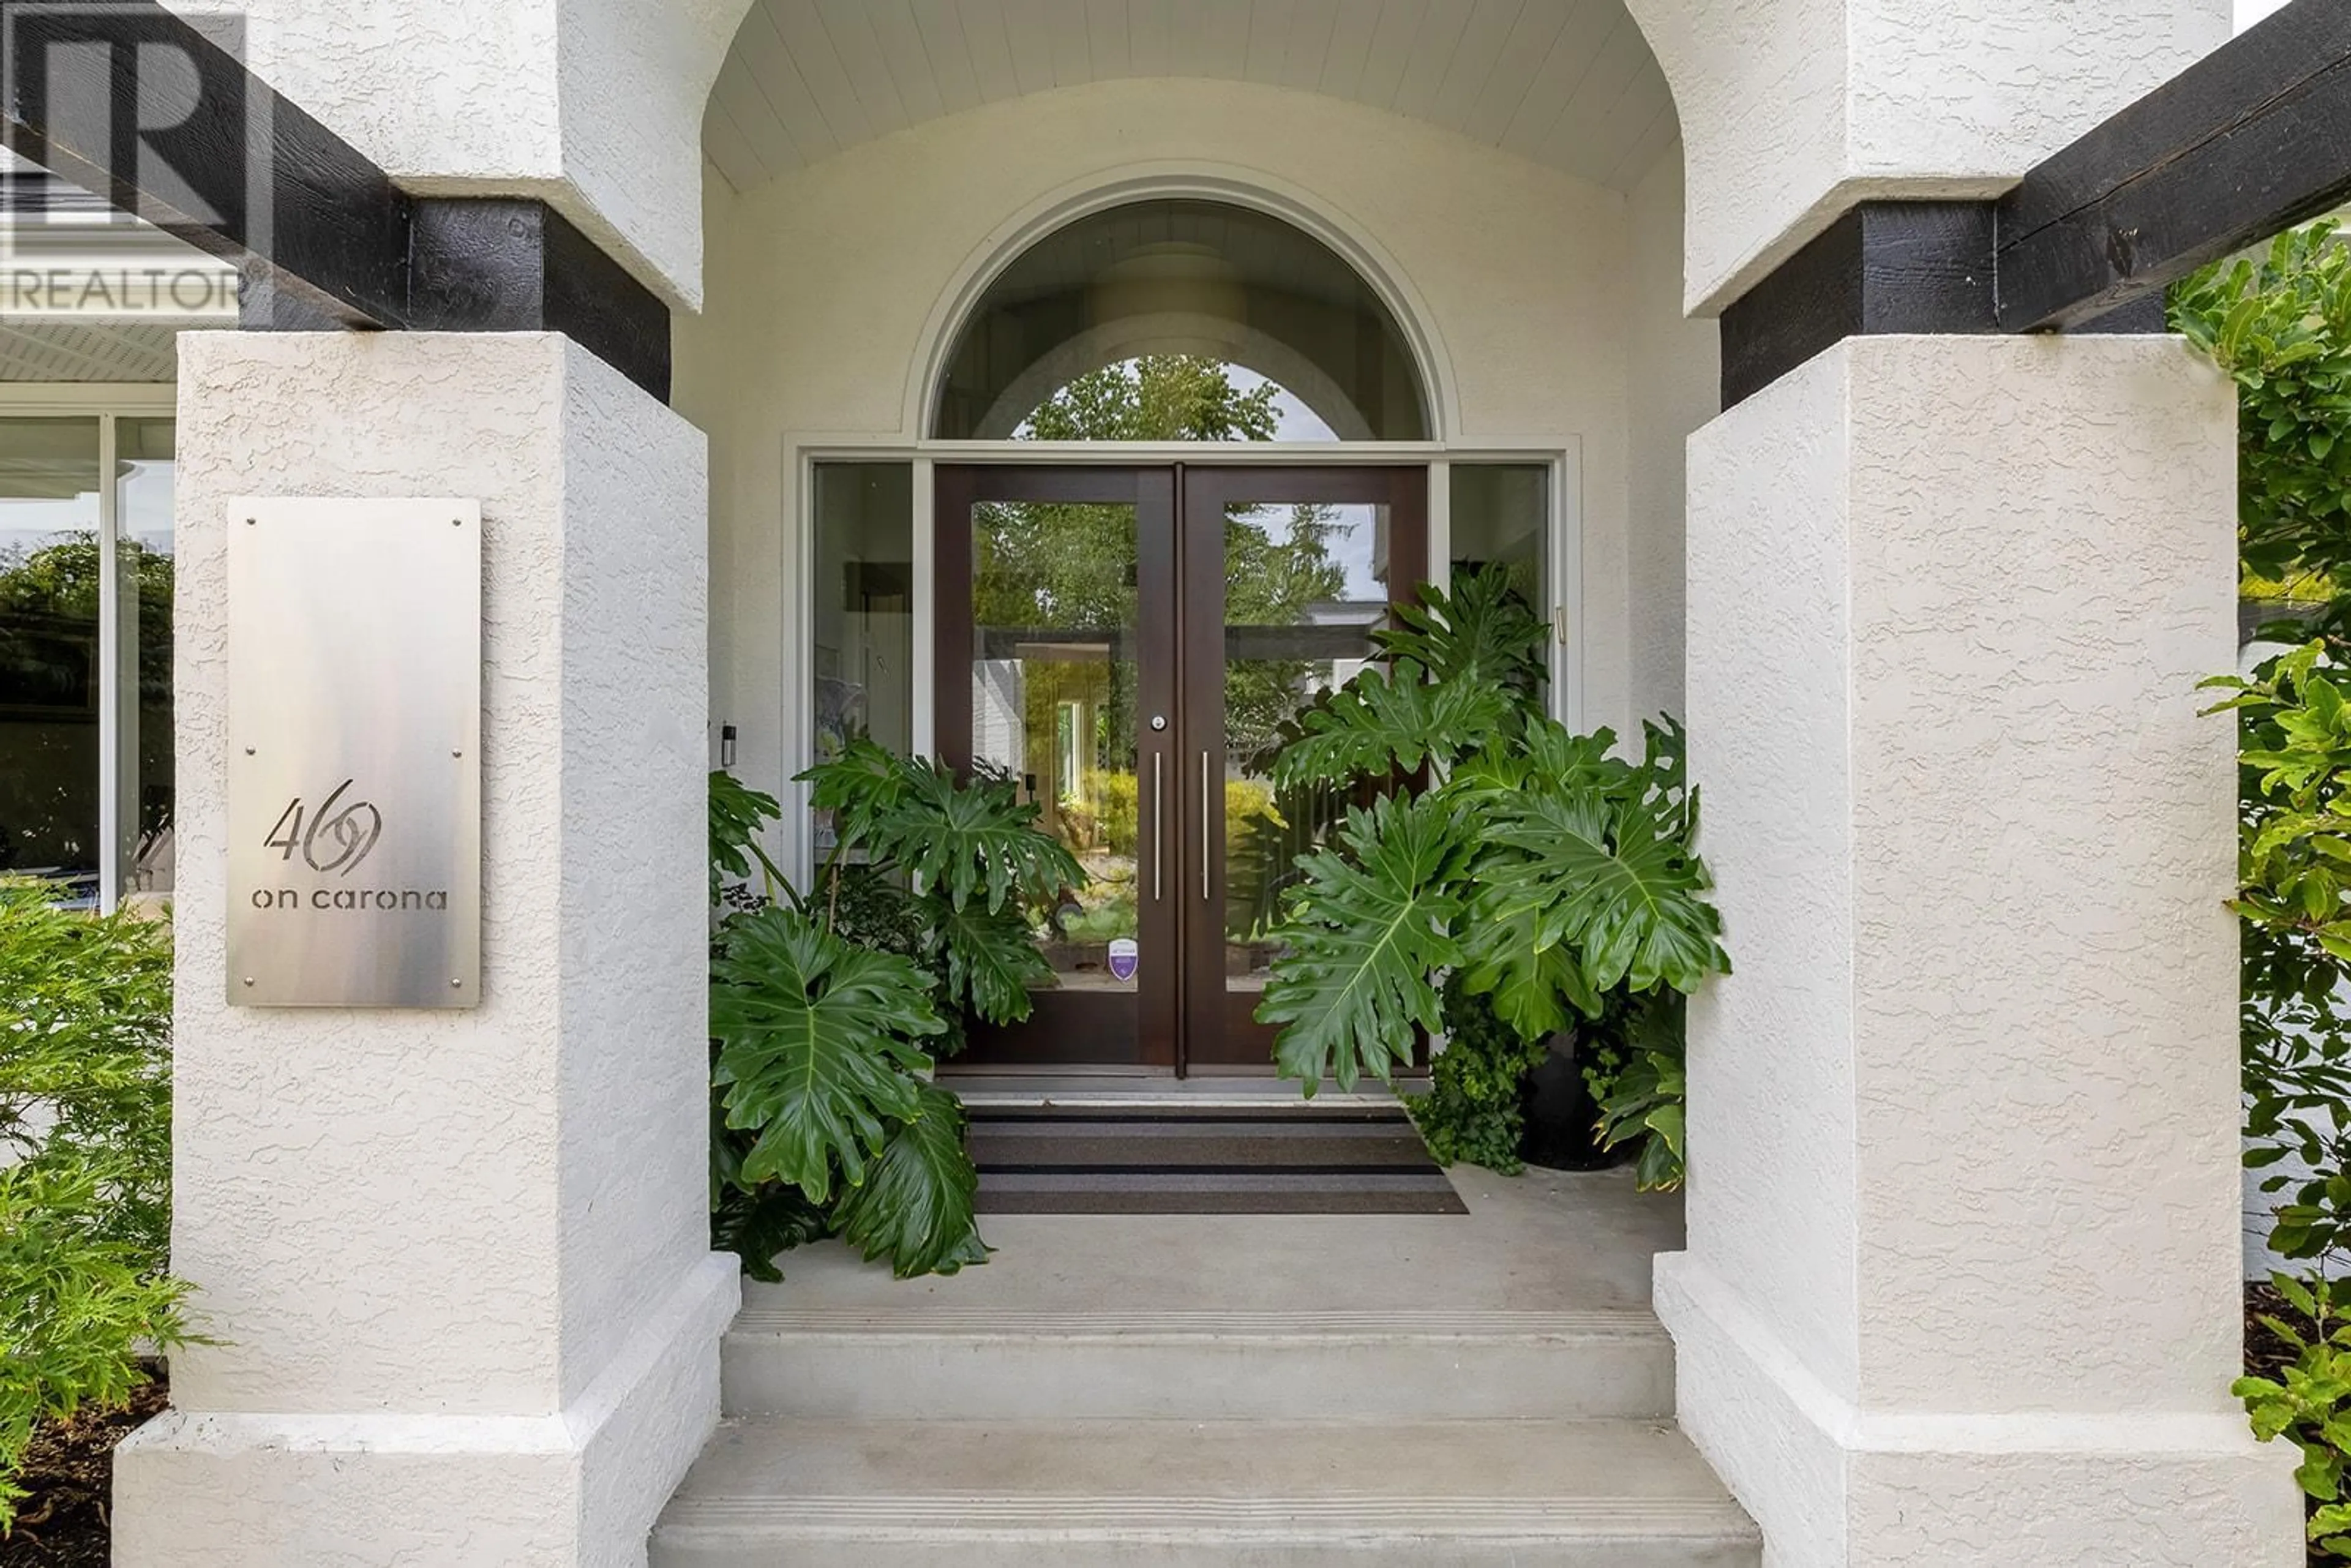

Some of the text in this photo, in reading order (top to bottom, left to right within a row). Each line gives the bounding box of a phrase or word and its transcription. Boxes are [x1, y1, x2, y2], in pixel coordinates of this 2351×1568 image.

[263, 778, 381, 877] 469
[252, 889, 448, 909] on carona
